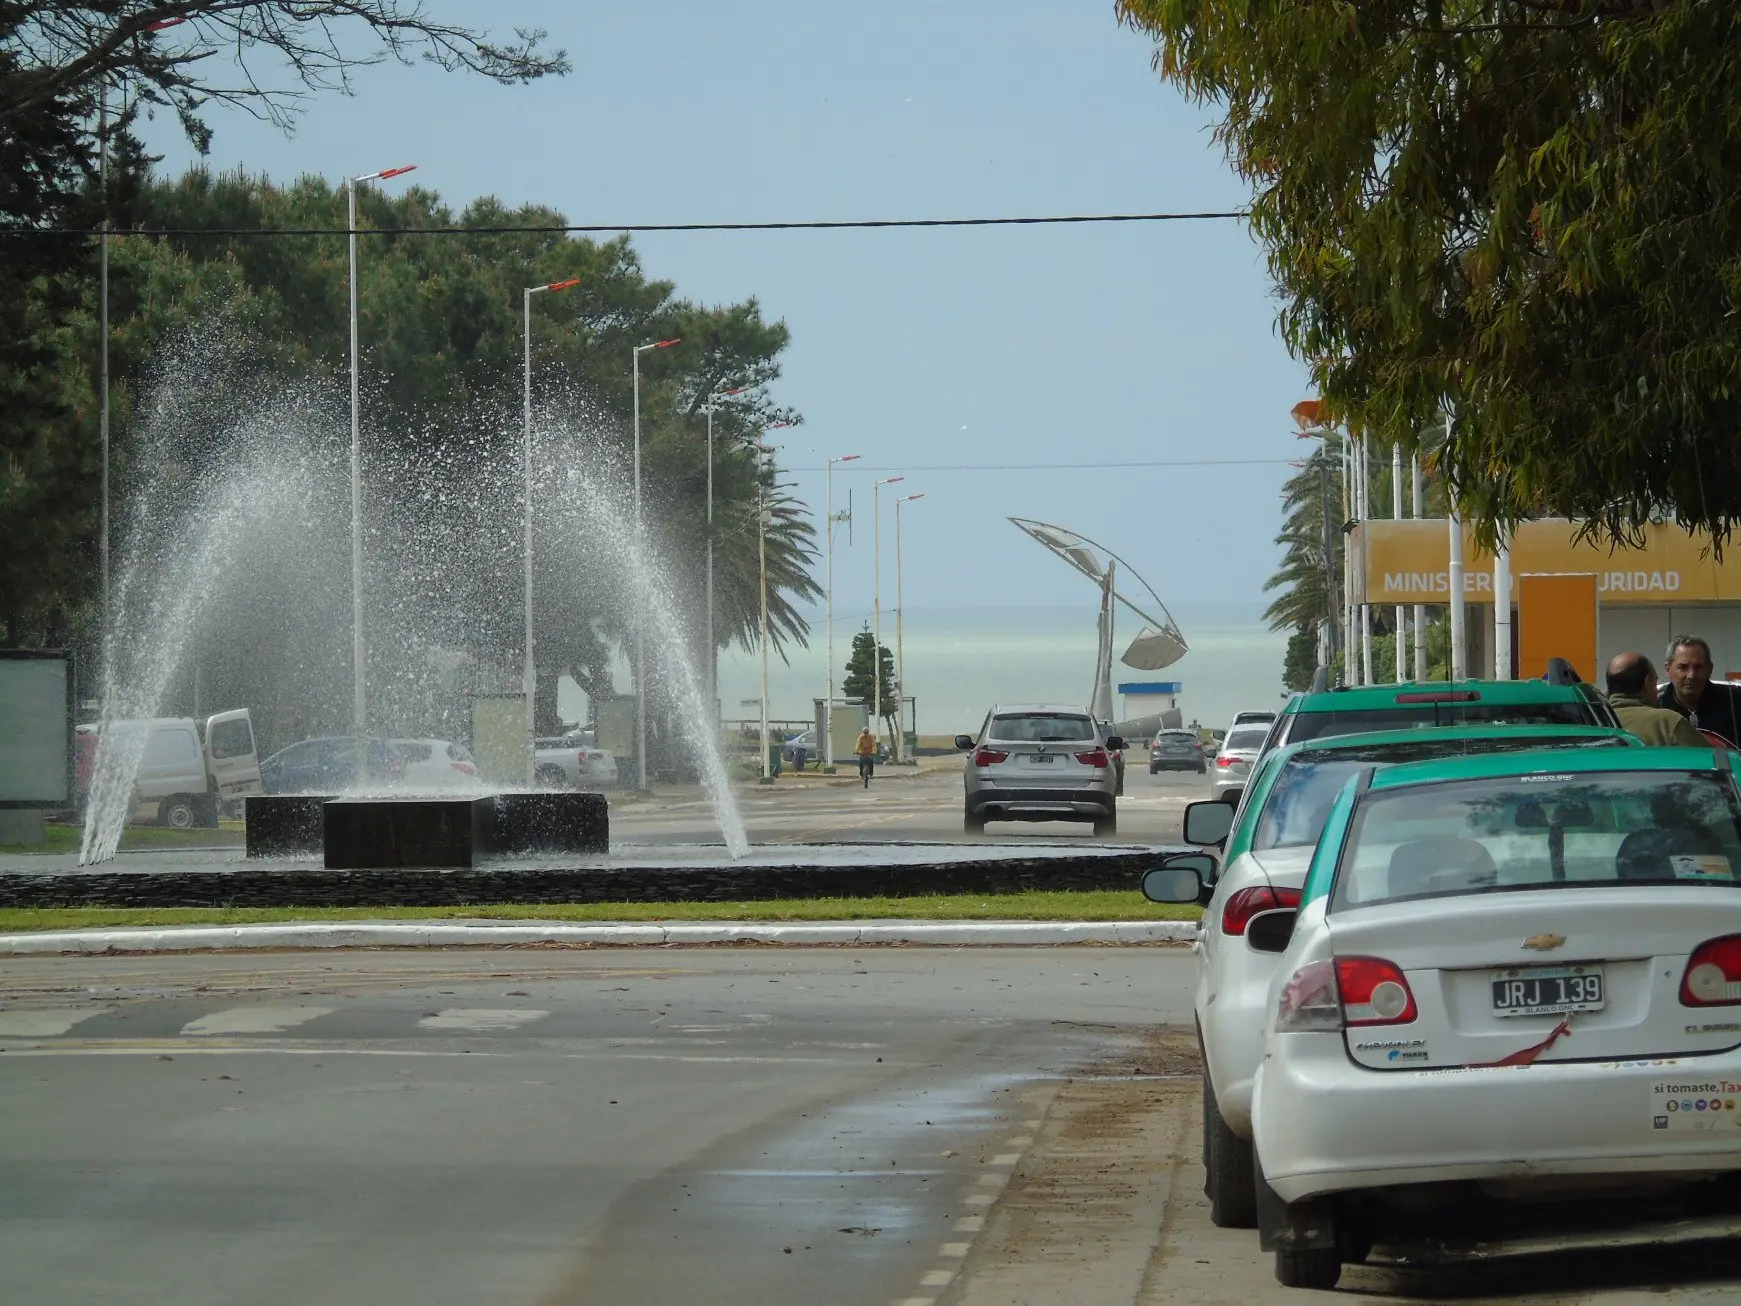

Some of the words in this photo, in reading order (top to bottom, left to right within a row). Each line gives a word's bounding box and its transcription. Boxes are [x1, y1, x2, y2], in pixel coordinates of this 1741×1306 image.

[1496, 981, 1541, 1007] JRJ
[1555, 976, 1600, 1004] 139
[1525, 1005, 1557, 1014] BLANCO
[1654, 1083, 1664, 1094] si
